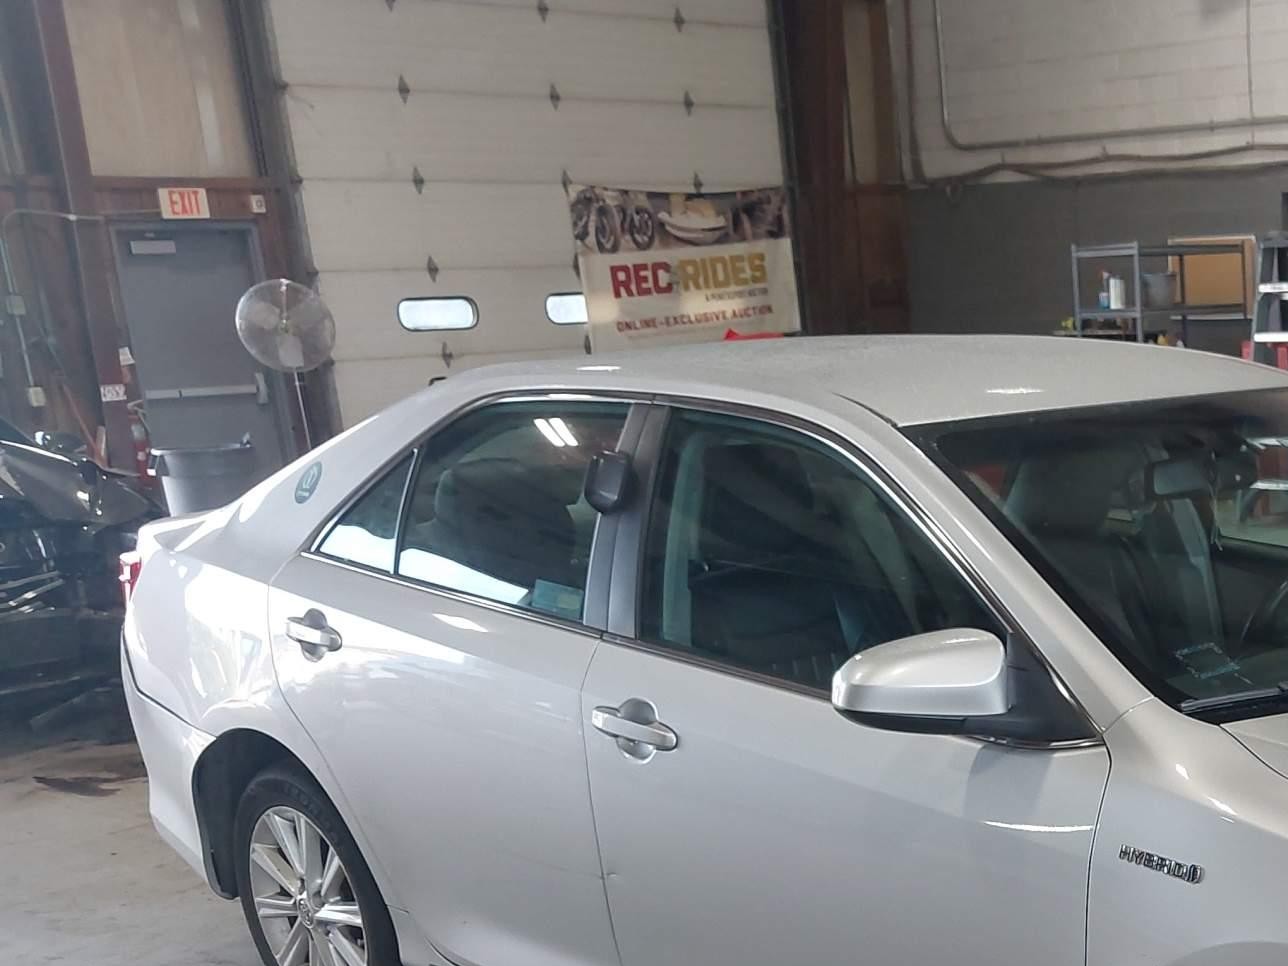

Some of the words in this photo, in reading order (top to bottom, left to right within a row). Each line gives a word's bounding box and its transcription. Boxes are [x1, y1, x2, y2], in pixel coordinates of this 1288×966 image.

[168, 190, 202, 216] EXIT
[610, 262, 673, 299] REC
[678, 253, 769, 292] RIDES
[732, 305, 774, 319] AUCTION
